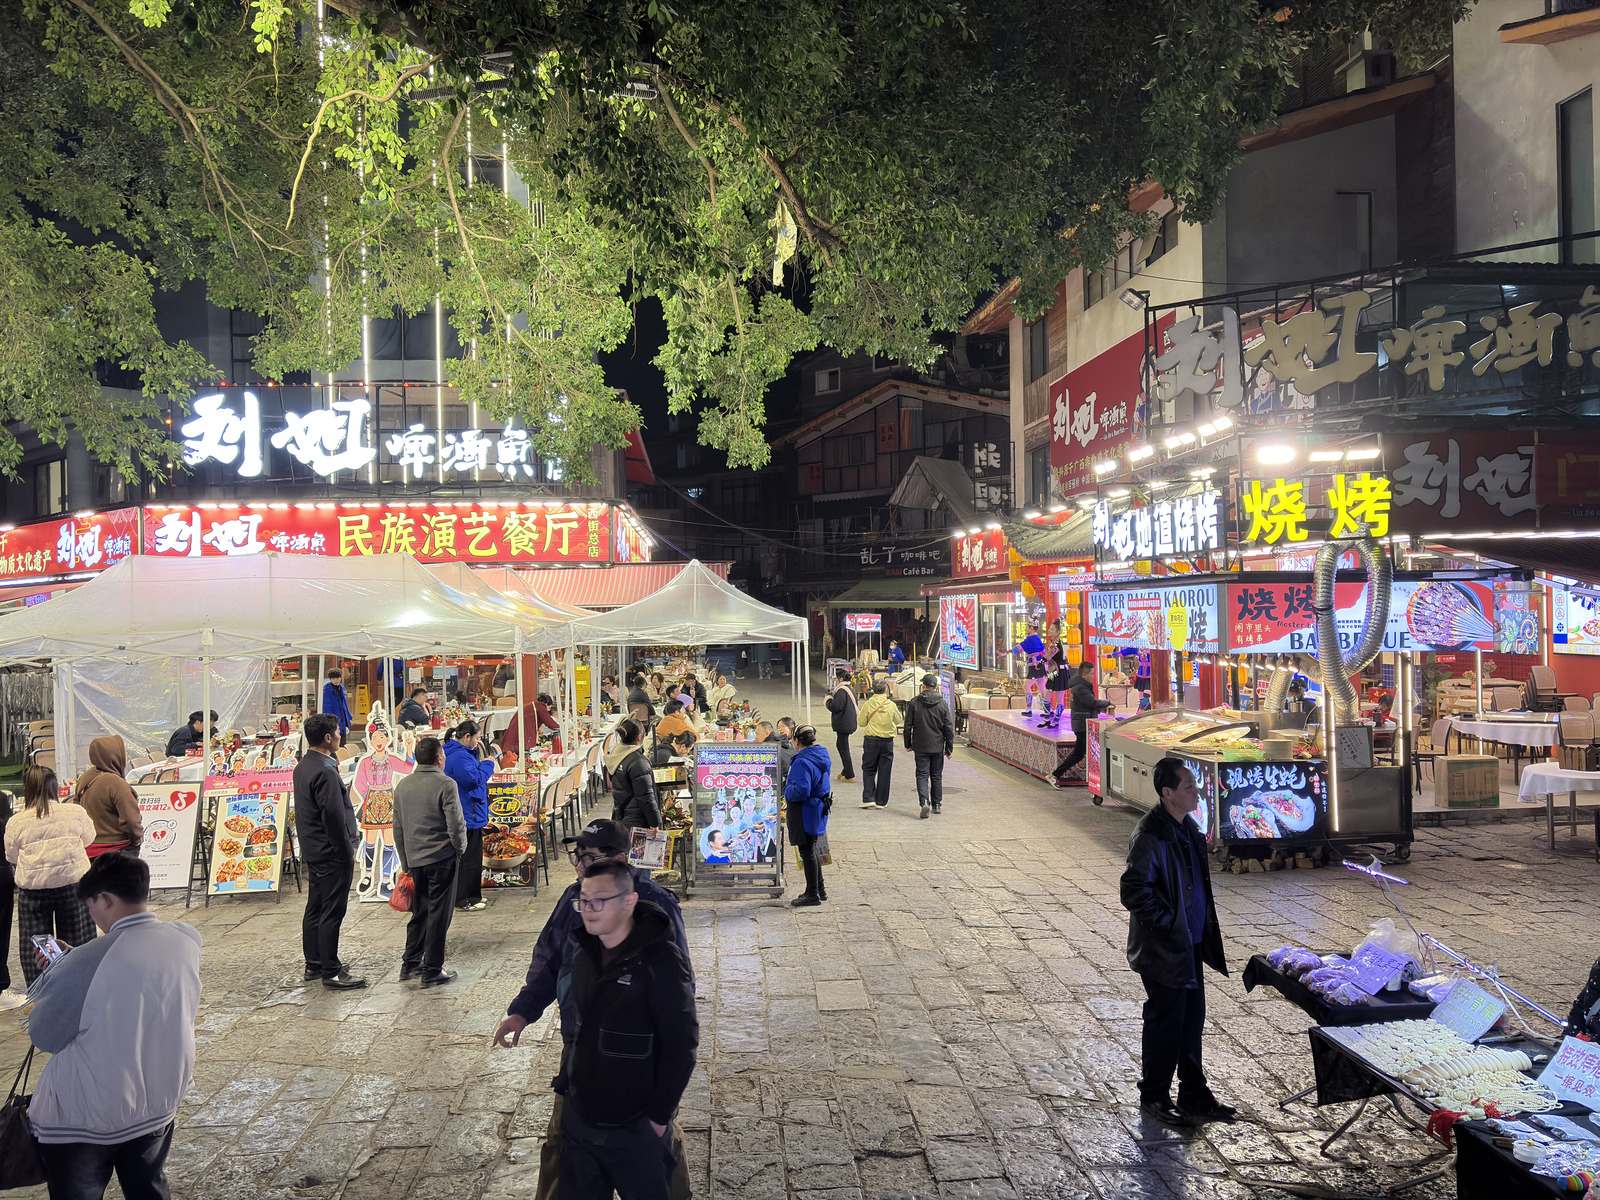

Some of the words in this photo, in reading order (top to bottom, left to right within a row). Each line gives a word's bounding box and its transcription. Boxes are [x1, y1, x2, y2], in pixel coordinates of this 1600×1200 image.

[1242, 472, 1392, 545] 烧烤
[337, 511, 580, 557] 民族演艺餐厅
[587, 507, 599, 559] 西街总店
[1093, 491, 1218, 561] 刘姐地道烧烤
[859, 547, 896, 565] 乱了
[900, 550, 941, 562] 咖啡吧
[903, 567, 920, 575] Café
[921, 567, 935, 575] Bar
[1091, 593, 1125, 609] MASTER
[1164, 588, 1215, 608] KAOROU
[1237, 584, 1314, 621] 烧烤
[1276, 621, 1305, 629] Master
[705, 778, 769, 787] 高山流水体验
[1226, 764, 1307, 790] 现烤生蚝
[137, 797, 161, 805] 音扫码
[1462, 1011, 1486, 1032] carving
[1554, 1073, 1596, 1098] 一擦见效
